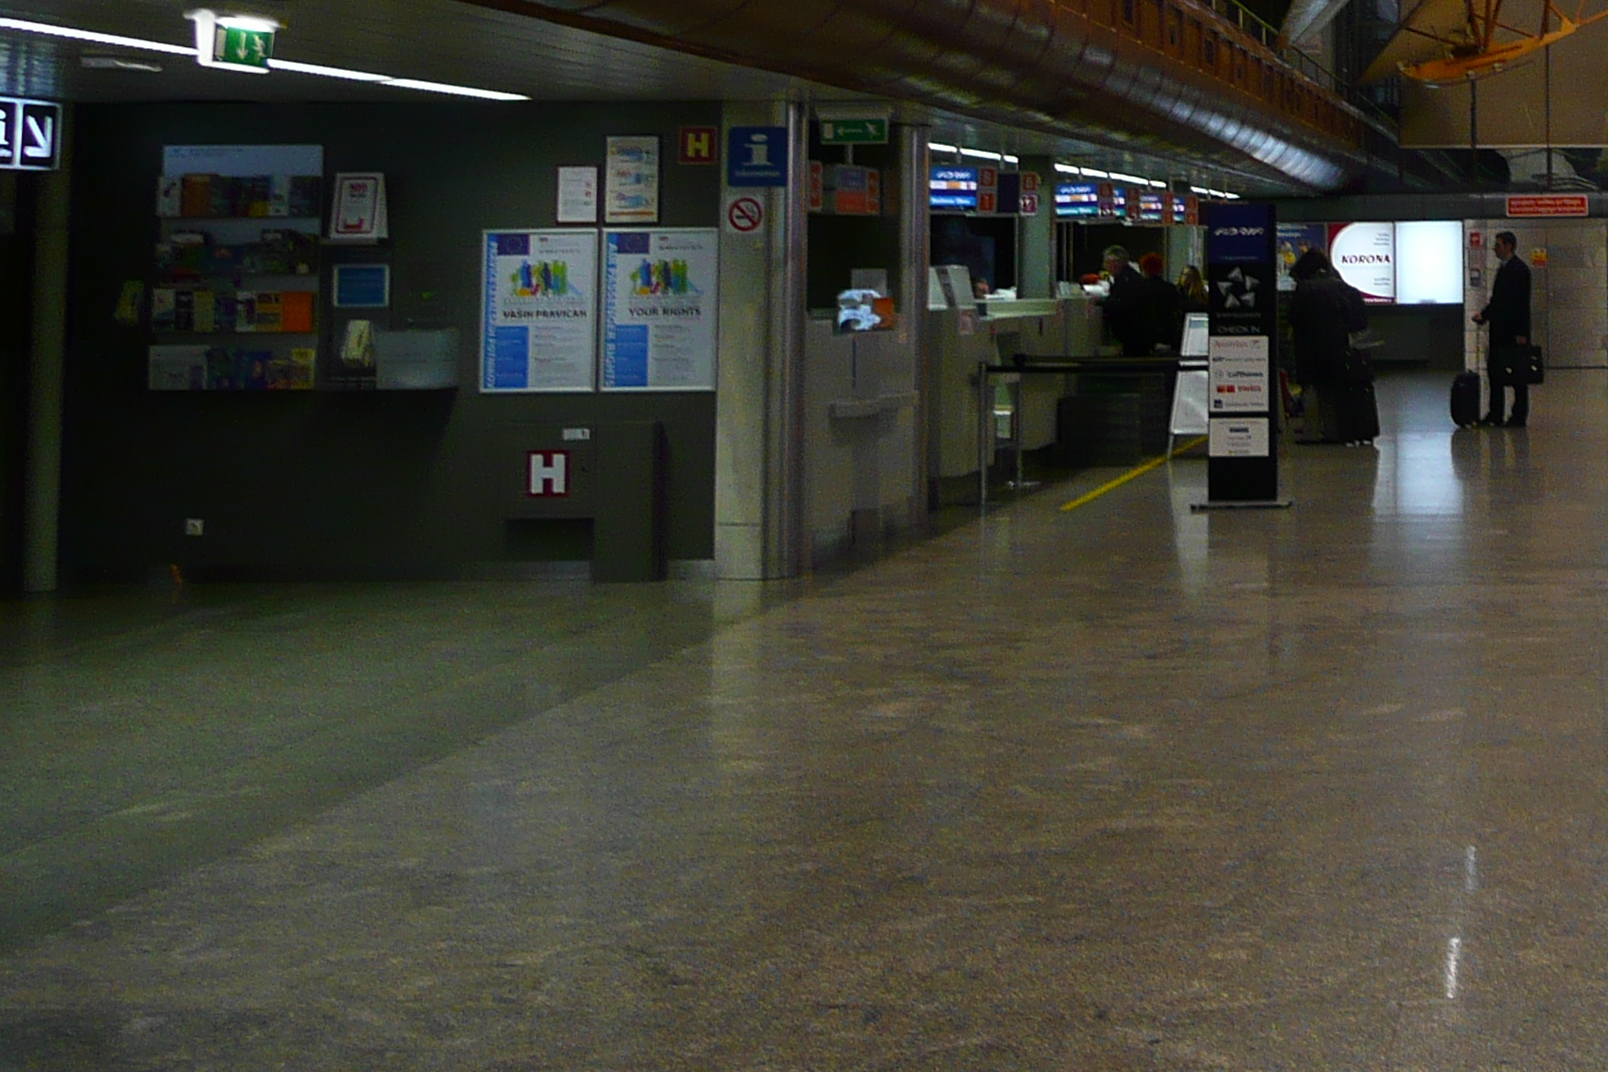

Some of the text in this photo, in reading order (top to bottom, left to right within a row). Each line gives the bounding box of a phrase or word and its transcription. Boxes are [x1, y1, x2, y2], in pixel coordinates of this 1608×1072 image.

[687, 132, 710, 158] H
[1340, 253, 1392, 265] KORONA
[628, 306, 703, 318] YOUR RIGHTS
[529, 451, 567, 495] H
